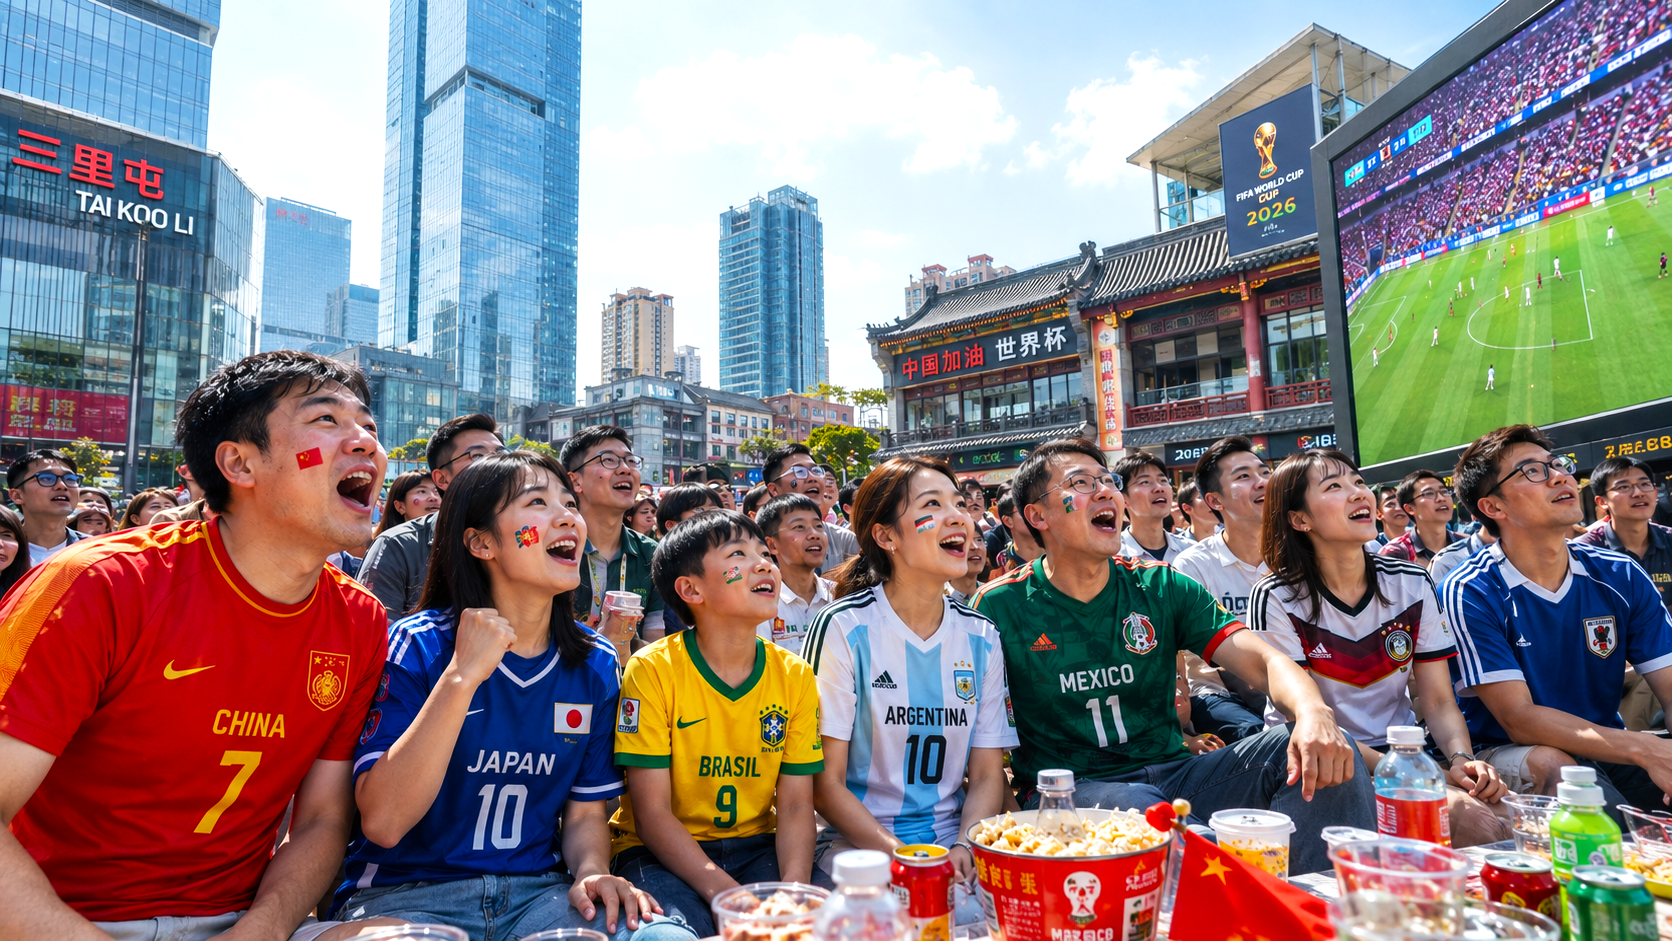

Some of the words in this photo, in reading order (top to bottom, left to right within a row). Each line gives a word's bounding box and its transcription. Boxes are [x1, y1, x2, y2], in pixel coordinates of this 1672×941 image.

[12, 129, 164, 200] 三里屯
[1236, 188, 1253, 202] FIFA
[1254, 177, 1284, 196] WORLD
[1286, 168, 1304, 183] CUP
[1258, 189, 1279, 204] CUP
[75, 189, 111, 218] TAI
[117, 199, 168, 229] KOO
[174, 212, 194, 236] LI
[1246, 197, 1297, 227] 2026
[902, 343, 984, 381] 中国加油
[995, 325, 1067, 362] 世界杯
[1059, 663, 1135, 694] MEXICO
[212, 708, 286, 738] CHINA
[884, 705, 968, 727] ARGENTINA
[1085, 694, 1128, 748] 11
[466, 749, 556, 775] JAPAN
[698, 755, 761, 778] BRASIL
[905, 734, 947, 785] 10
[193, 750, 263, 834] 7
[713, 785, 738, 829] 9
[472, 783, 529, 850] 10
